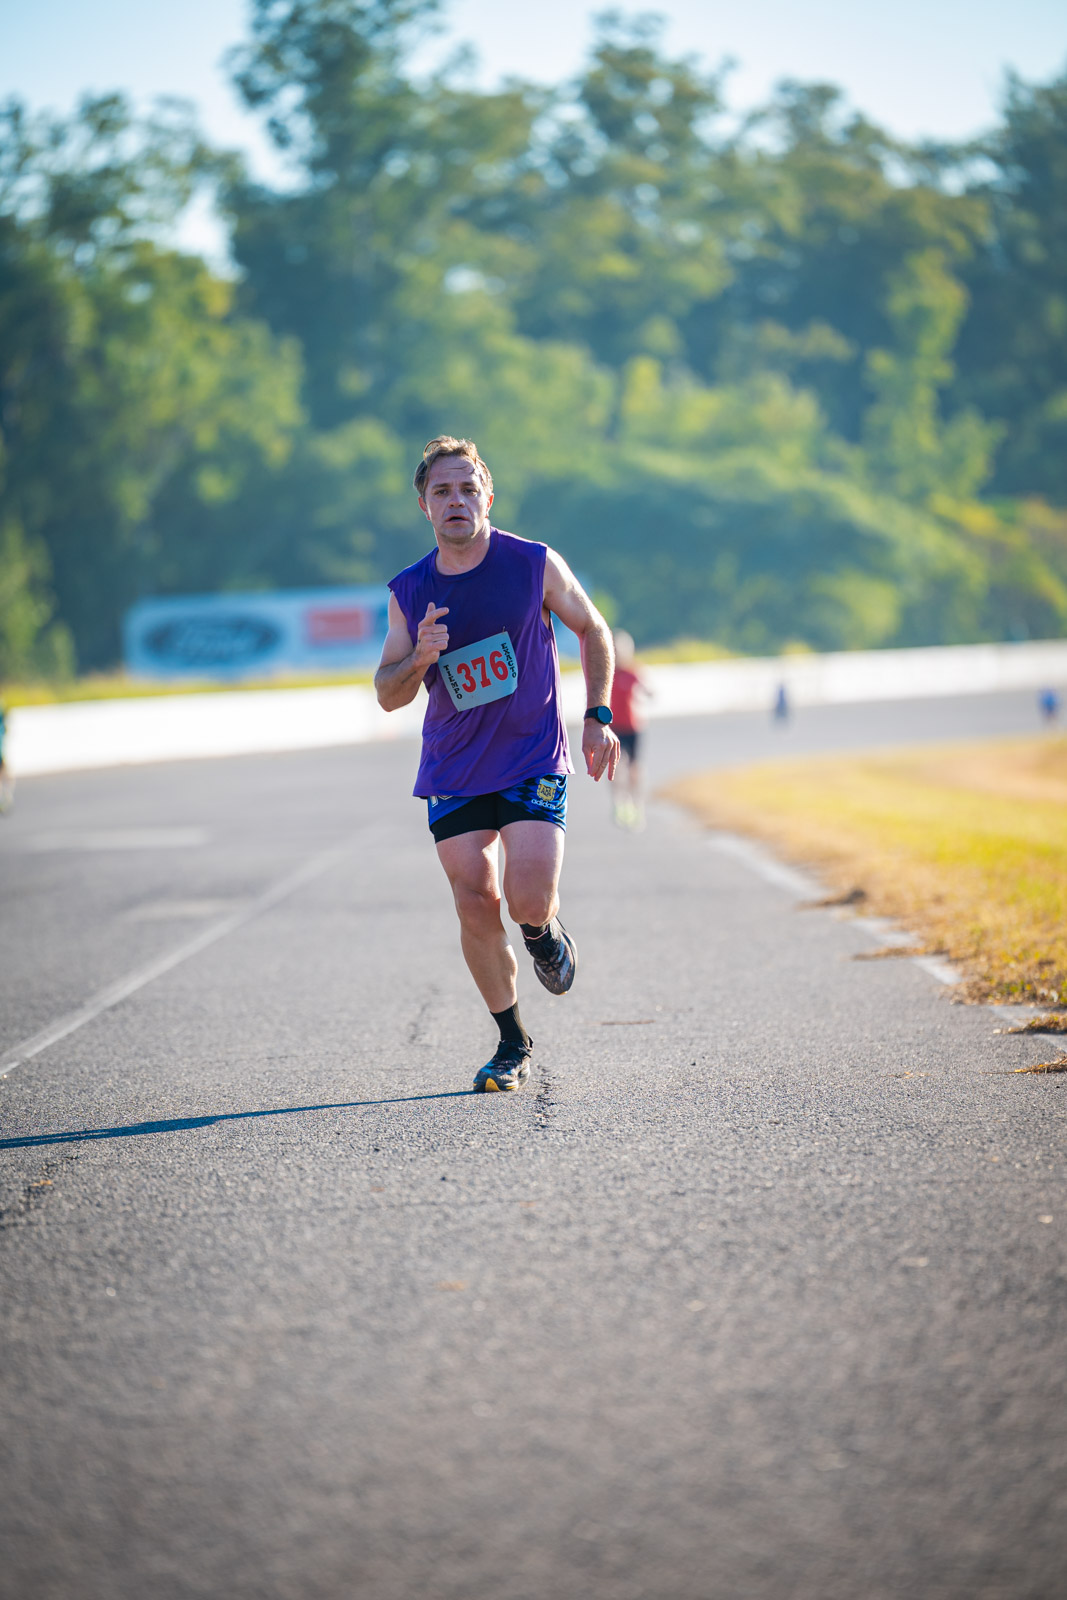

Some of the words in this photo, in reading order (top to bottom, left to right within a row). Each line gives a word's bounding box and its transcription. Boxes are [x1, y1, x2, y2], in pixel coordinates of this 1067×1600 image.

[456, 650, 509, 693] 376
[501, 642, 517, 679] EXACTO
[443, 664, 463, 700] TIEMPO
